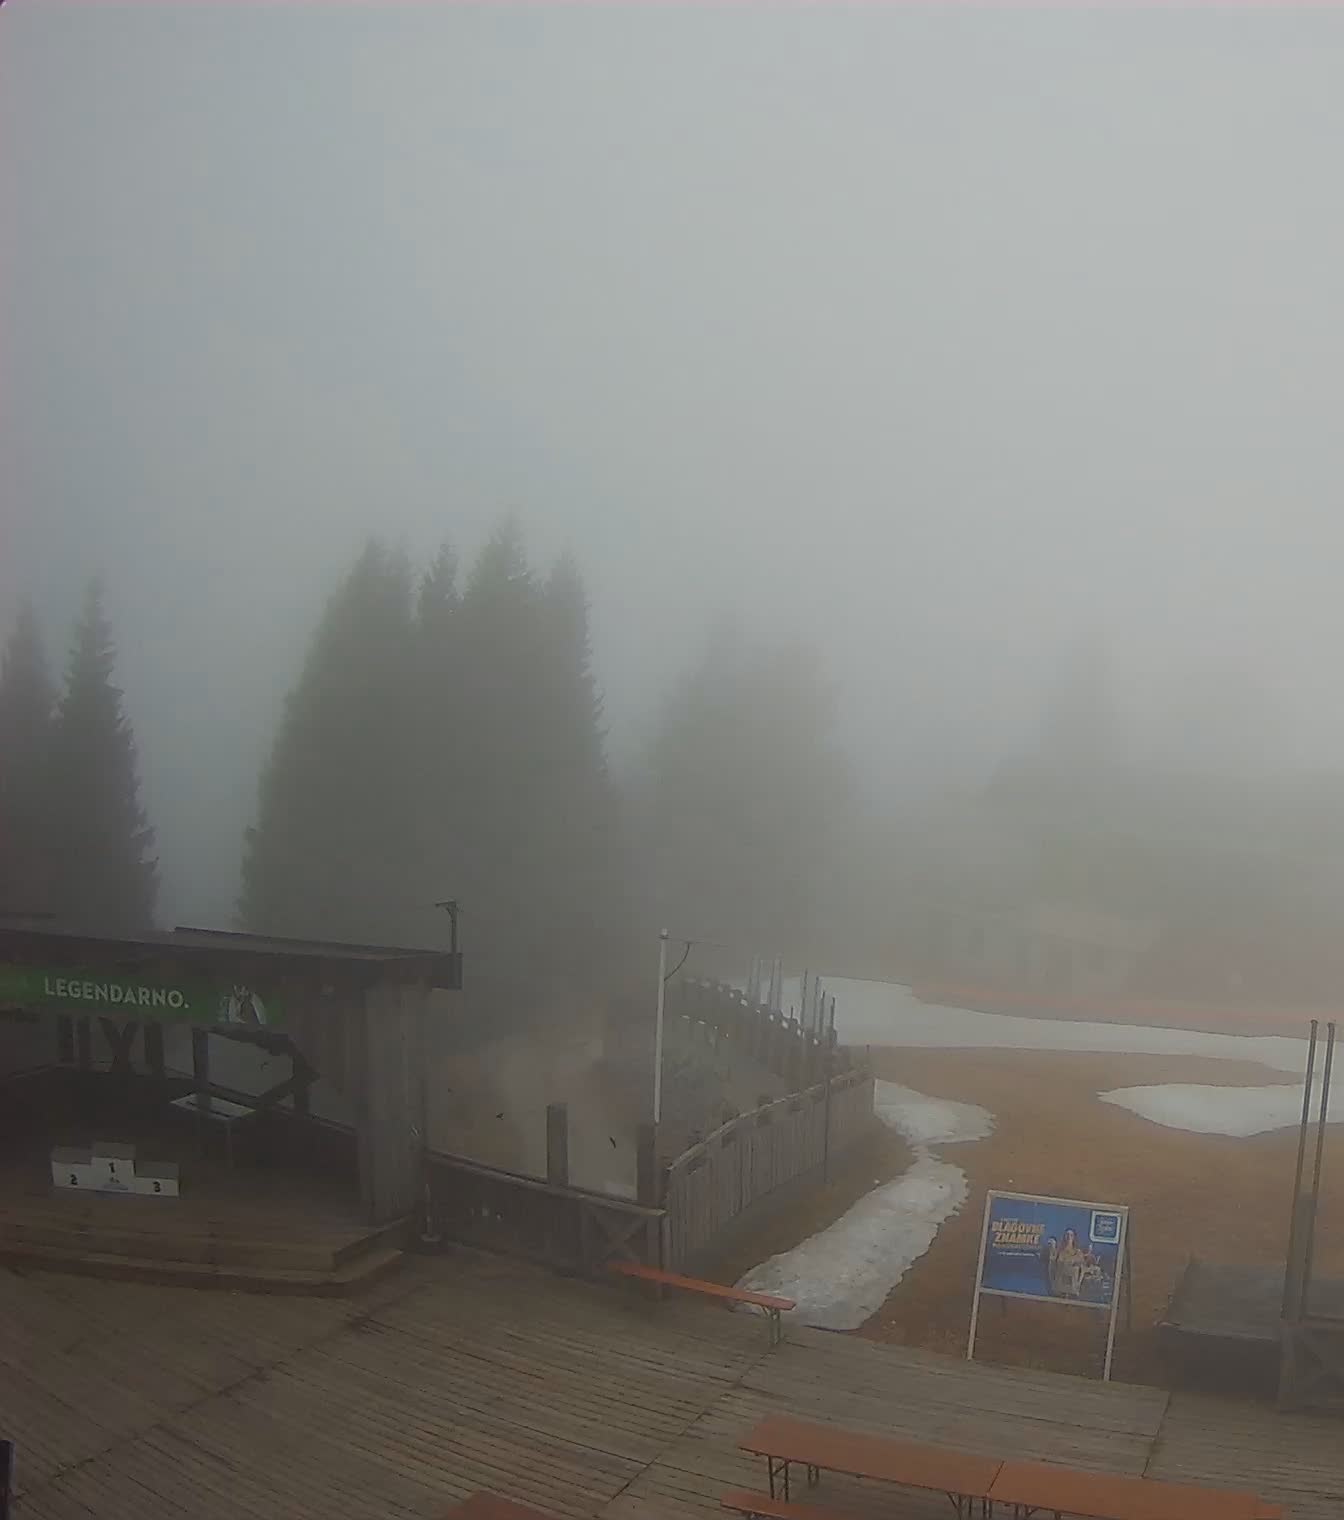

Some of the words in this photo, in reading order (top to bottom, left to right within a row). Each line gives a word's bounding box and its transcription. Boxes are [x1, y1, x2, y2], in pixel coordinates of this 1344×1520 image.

[44, 977, 190, 1009] LEGENDARNO.
[108, 1162, 116, 1173] 1
[70, 1174, 78, 1185] 2
[152, 1181, 161, 1193] 3
[994, 1232, 1041, 1245] ZNAMKE
